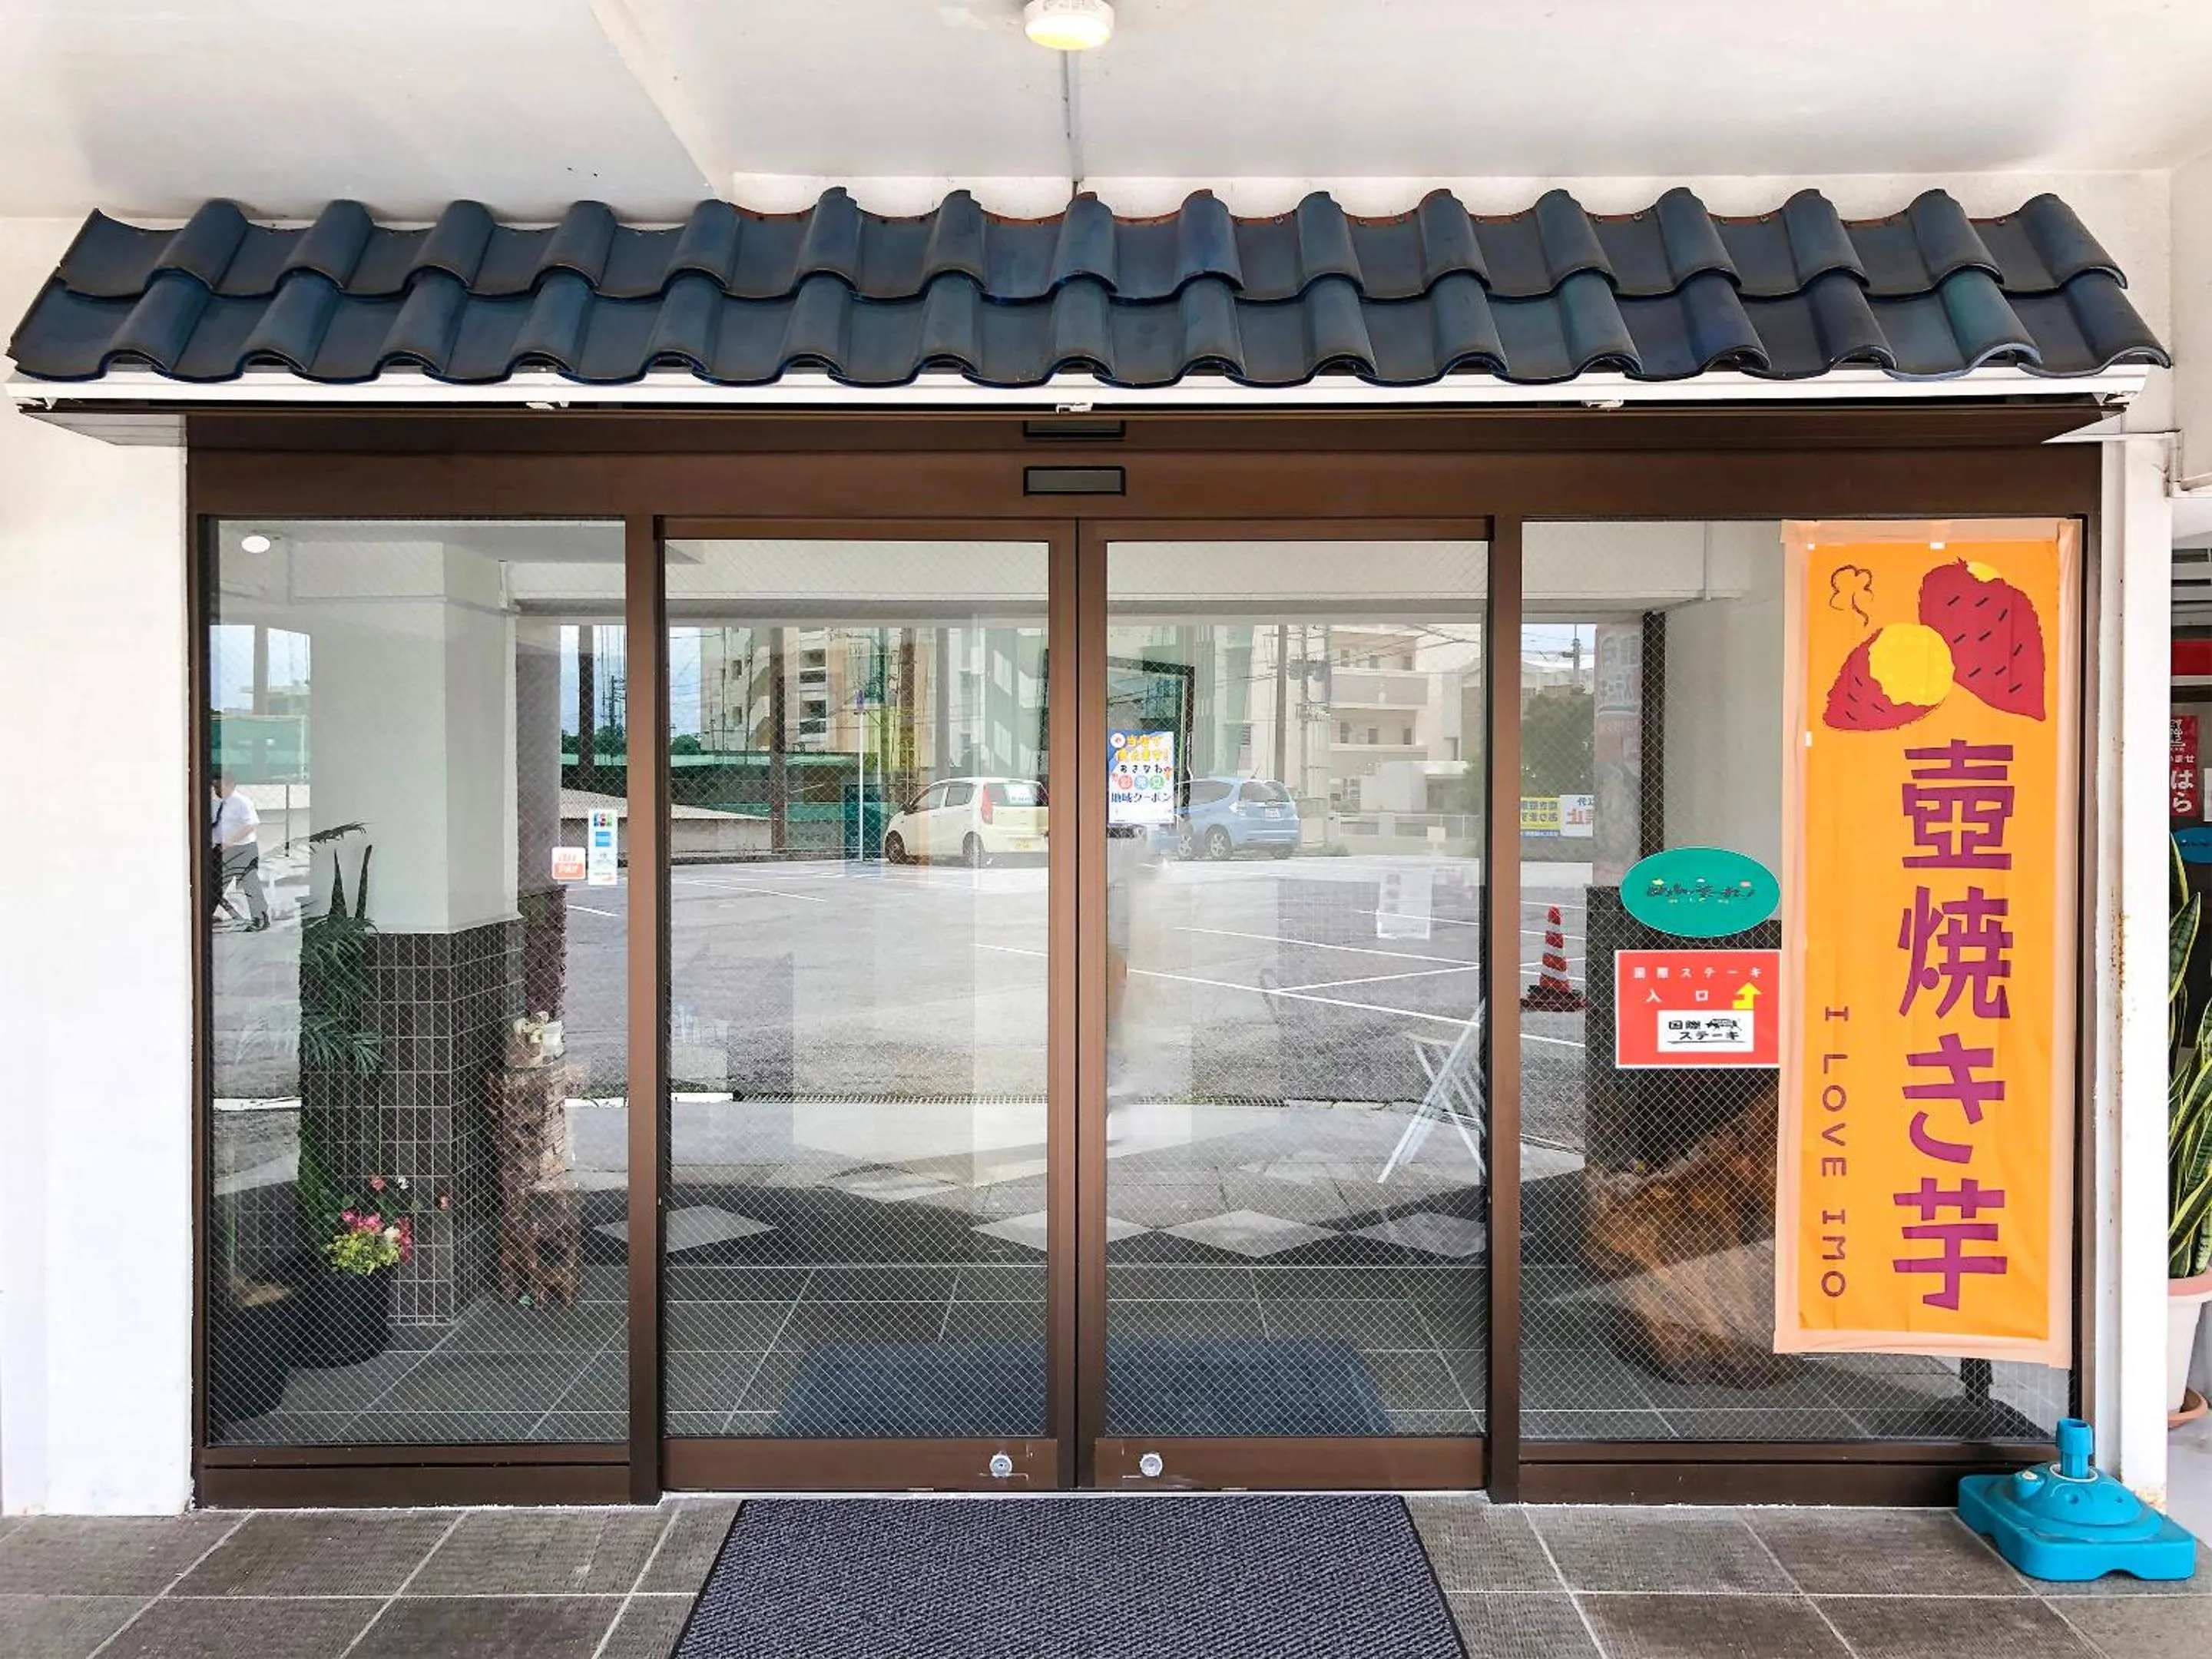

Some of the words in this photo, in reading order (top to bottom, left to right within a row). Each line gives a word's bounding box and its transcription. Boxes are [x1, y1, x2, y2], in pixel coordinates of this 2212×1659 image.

[1892, 738, 2015, 1310] 壺焼き芋
[1822, 1054, 1848, 1177] LOVE
[1820, 1209, 1846, 1298] IMO
